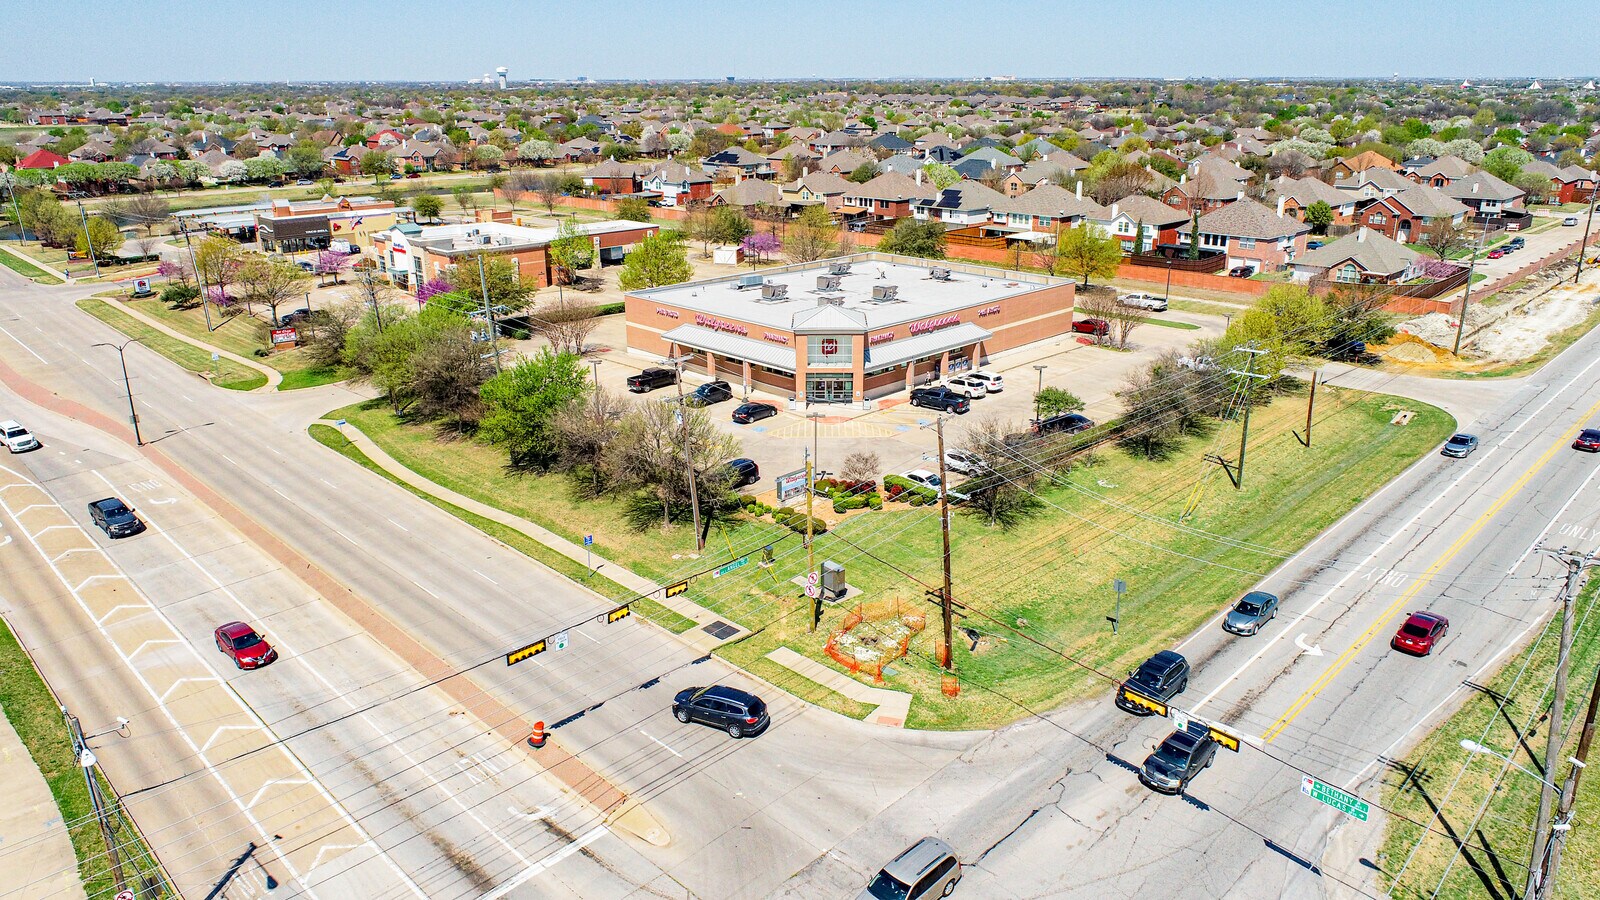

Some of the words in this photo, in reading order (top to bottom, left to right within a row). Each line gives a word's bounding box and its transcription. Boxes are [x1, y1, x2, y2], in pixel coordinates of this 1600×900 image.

[695, 313, 748, 333] Walgreens
[909, 313, 960, 334] Walgreens
[1559, 523, 1600, 541] ONLY
[1360, 566, 1409, 588] ONLY
[1322, 785, 1354, 805] BETHANY
[1322, 794, 1347, 811] LUCAS
